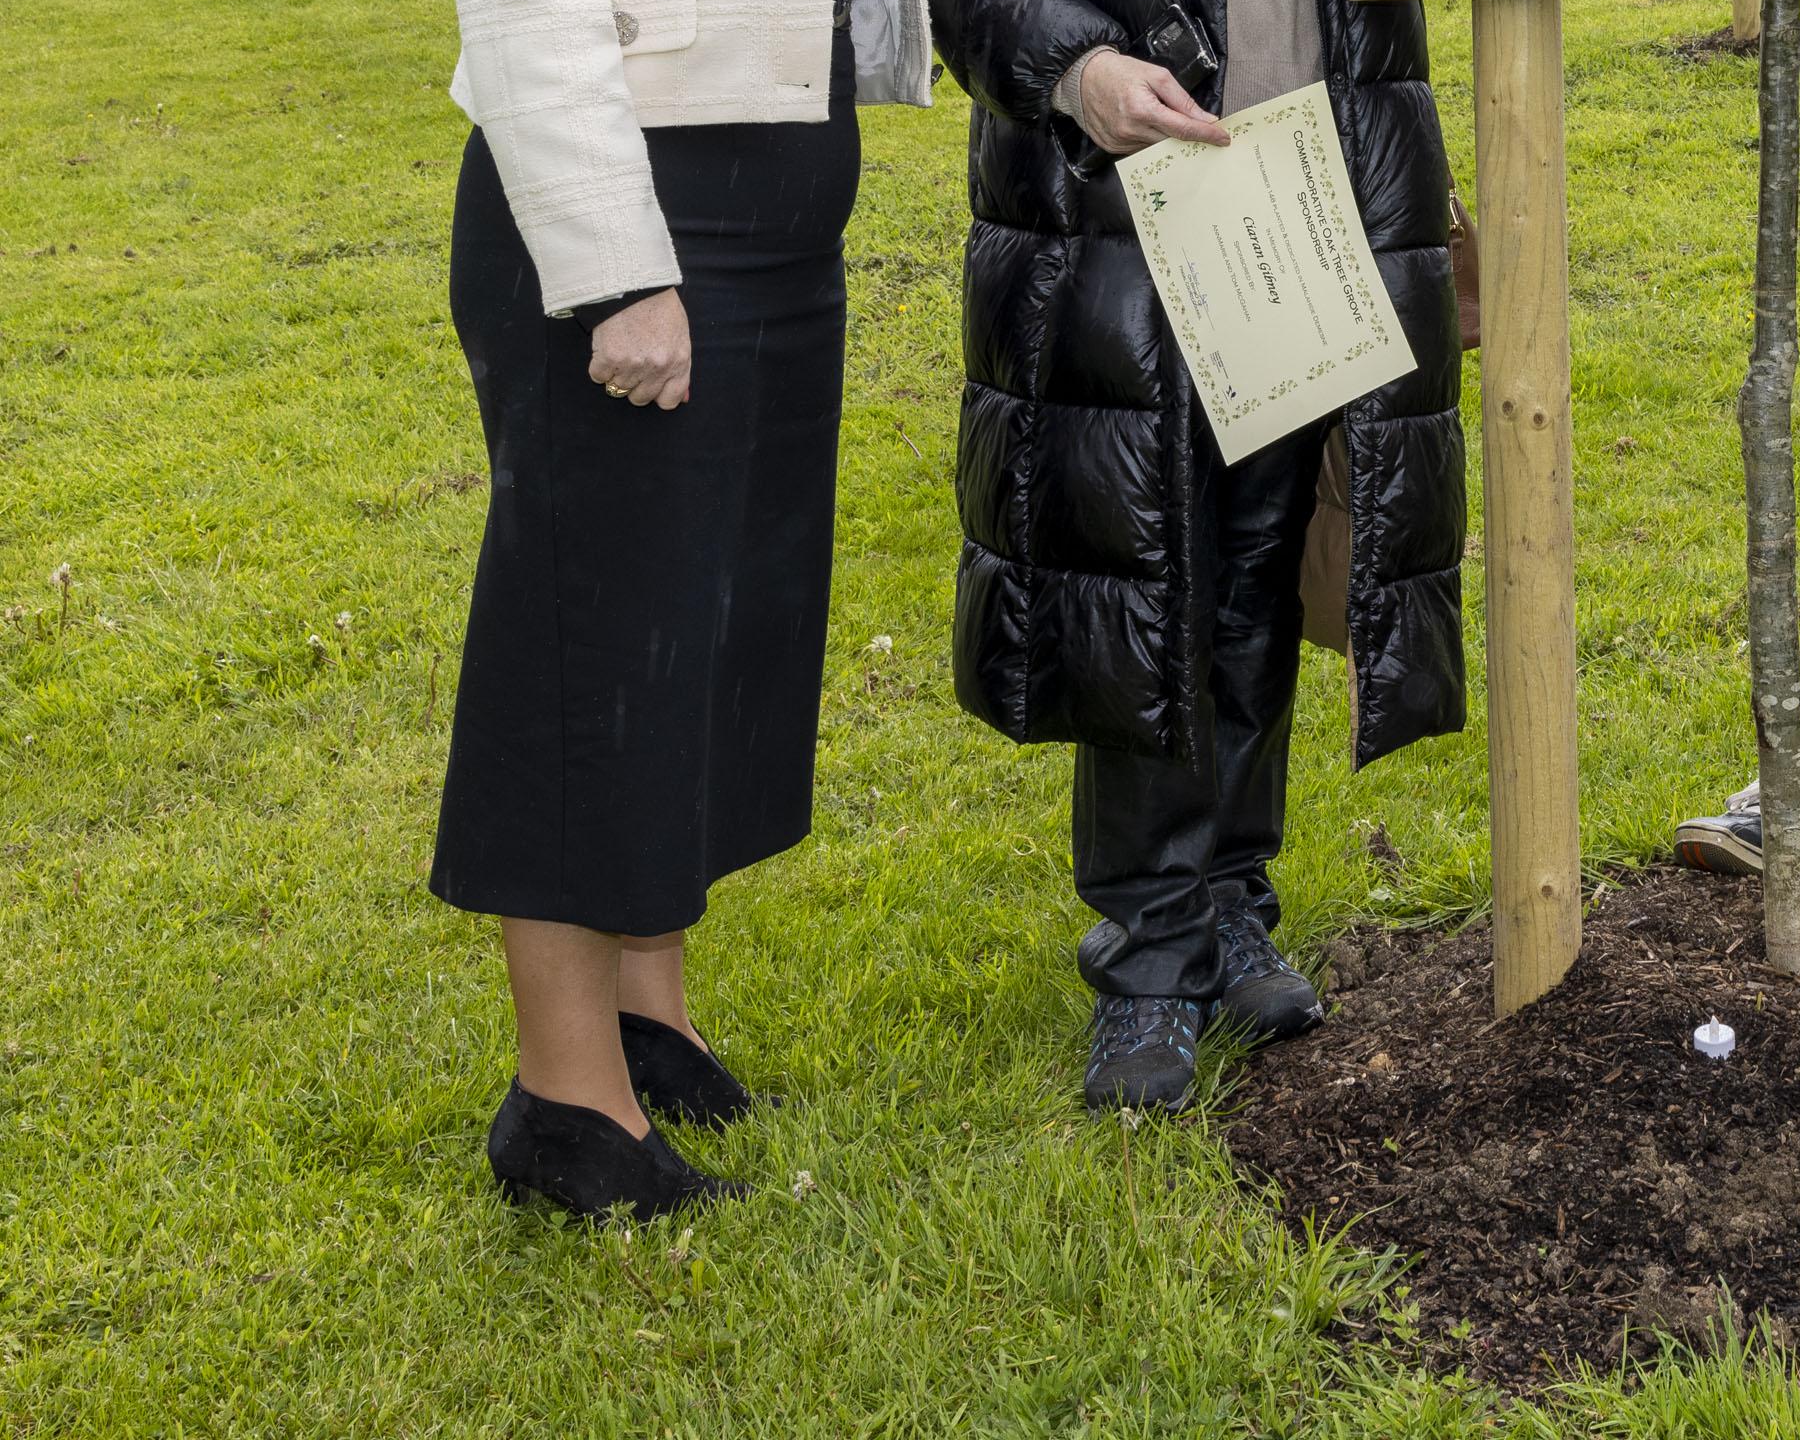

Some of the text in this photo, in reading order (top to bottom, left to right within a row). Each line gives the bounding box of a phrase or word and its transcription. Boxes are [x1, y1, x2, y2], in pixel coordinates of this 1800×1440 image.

[1253, 143, 1261, 160] TREE
[1258, 161, 1270, 188] NUMBER
[1272, 203, 1285, 232] PLANTED
[1284, 239, 1300, 274] DEDICATED
[1268, 236, 1281, 263] MEMORY
[1294, 130, 1363, 324] COMMEMORATIVE OAK TREE GROVE
[1297, 191, 1330, 271] SPONSORSHIP
[1232, 240, 1251, 281] SPONSORED
[1242, 216, 1281, 303] Ciaran Gibney
